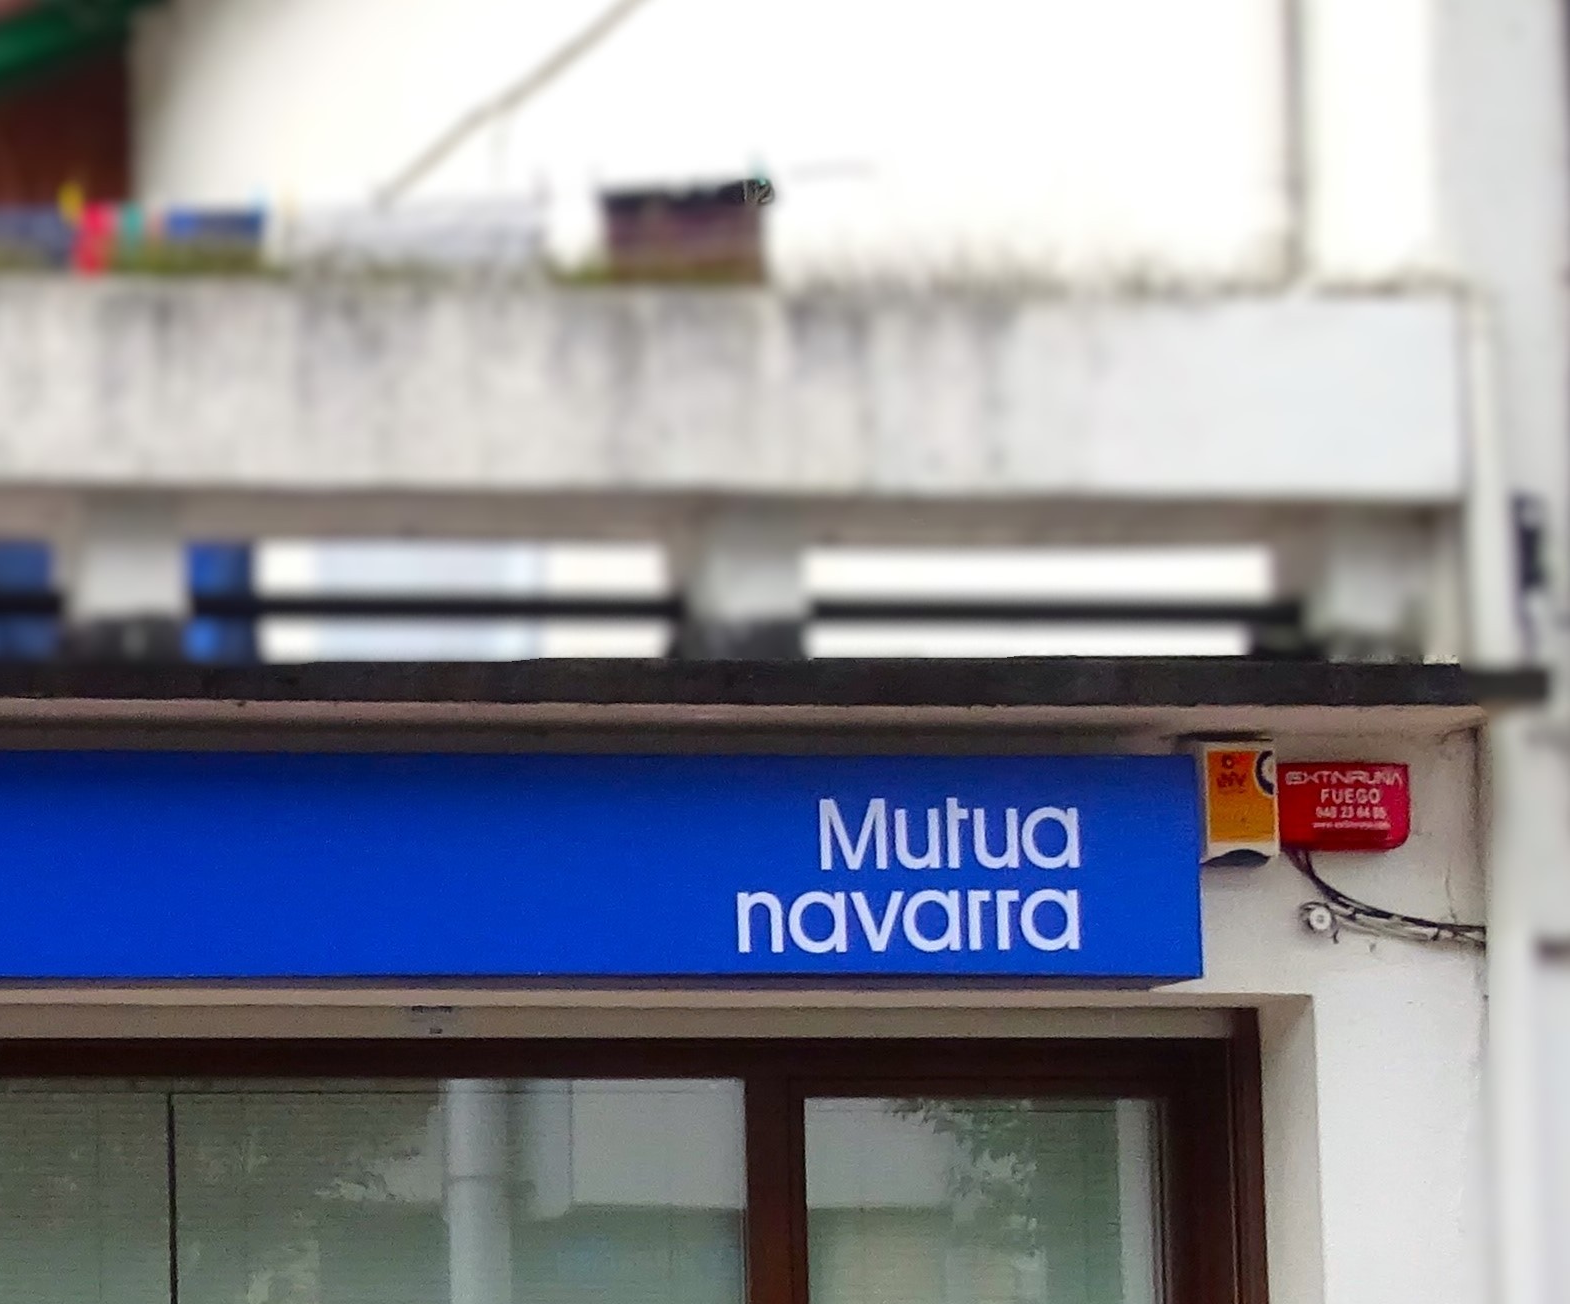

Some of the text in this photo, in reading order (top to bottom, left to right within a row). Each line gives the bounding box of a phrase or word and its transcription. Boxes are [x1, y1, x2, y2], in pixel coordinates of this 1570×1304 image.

[1320, 788, 1381, 804] FUEGO
[818, 797, 1081, 870] Mutua
[737, 888, 1081, 954] navarra
